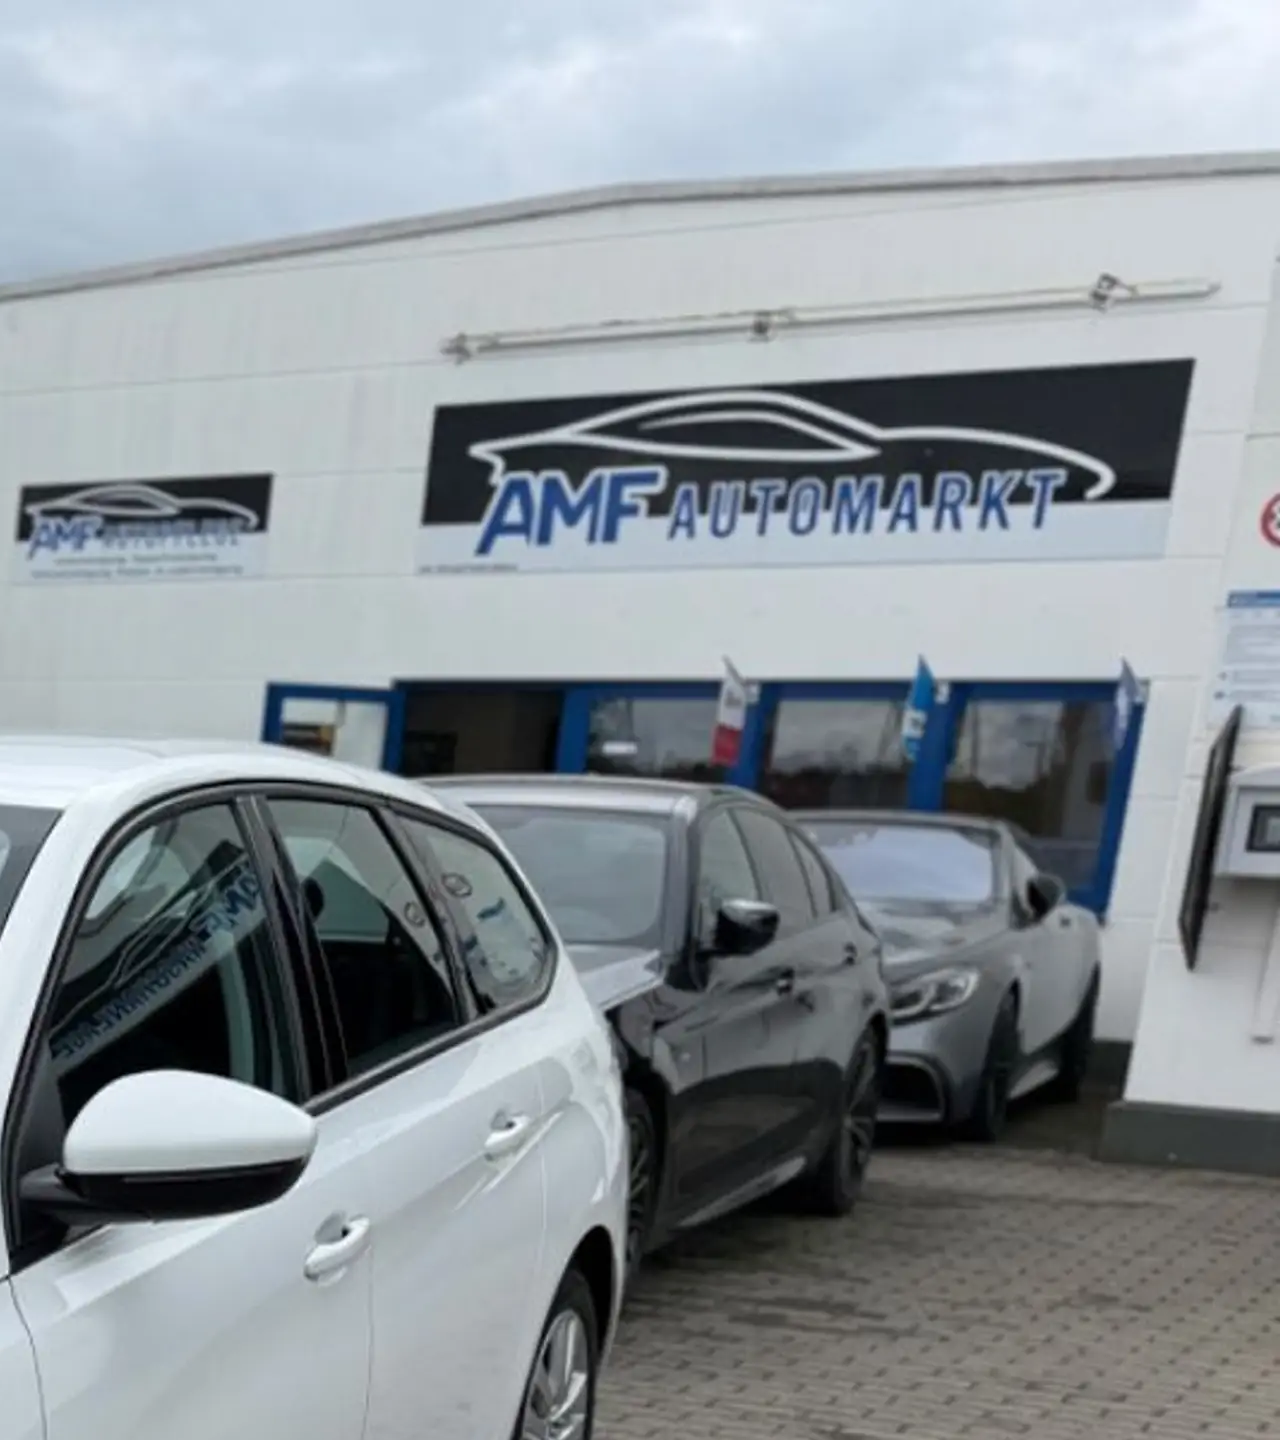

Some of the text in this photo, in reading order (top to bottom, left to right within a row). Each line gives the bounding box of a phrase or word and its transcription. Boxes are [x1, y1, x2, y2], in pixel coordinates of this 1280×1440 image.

[28, 514, 101, 561] AMF
[476, 467, 1067, 557] AMF AUTOMARKT
